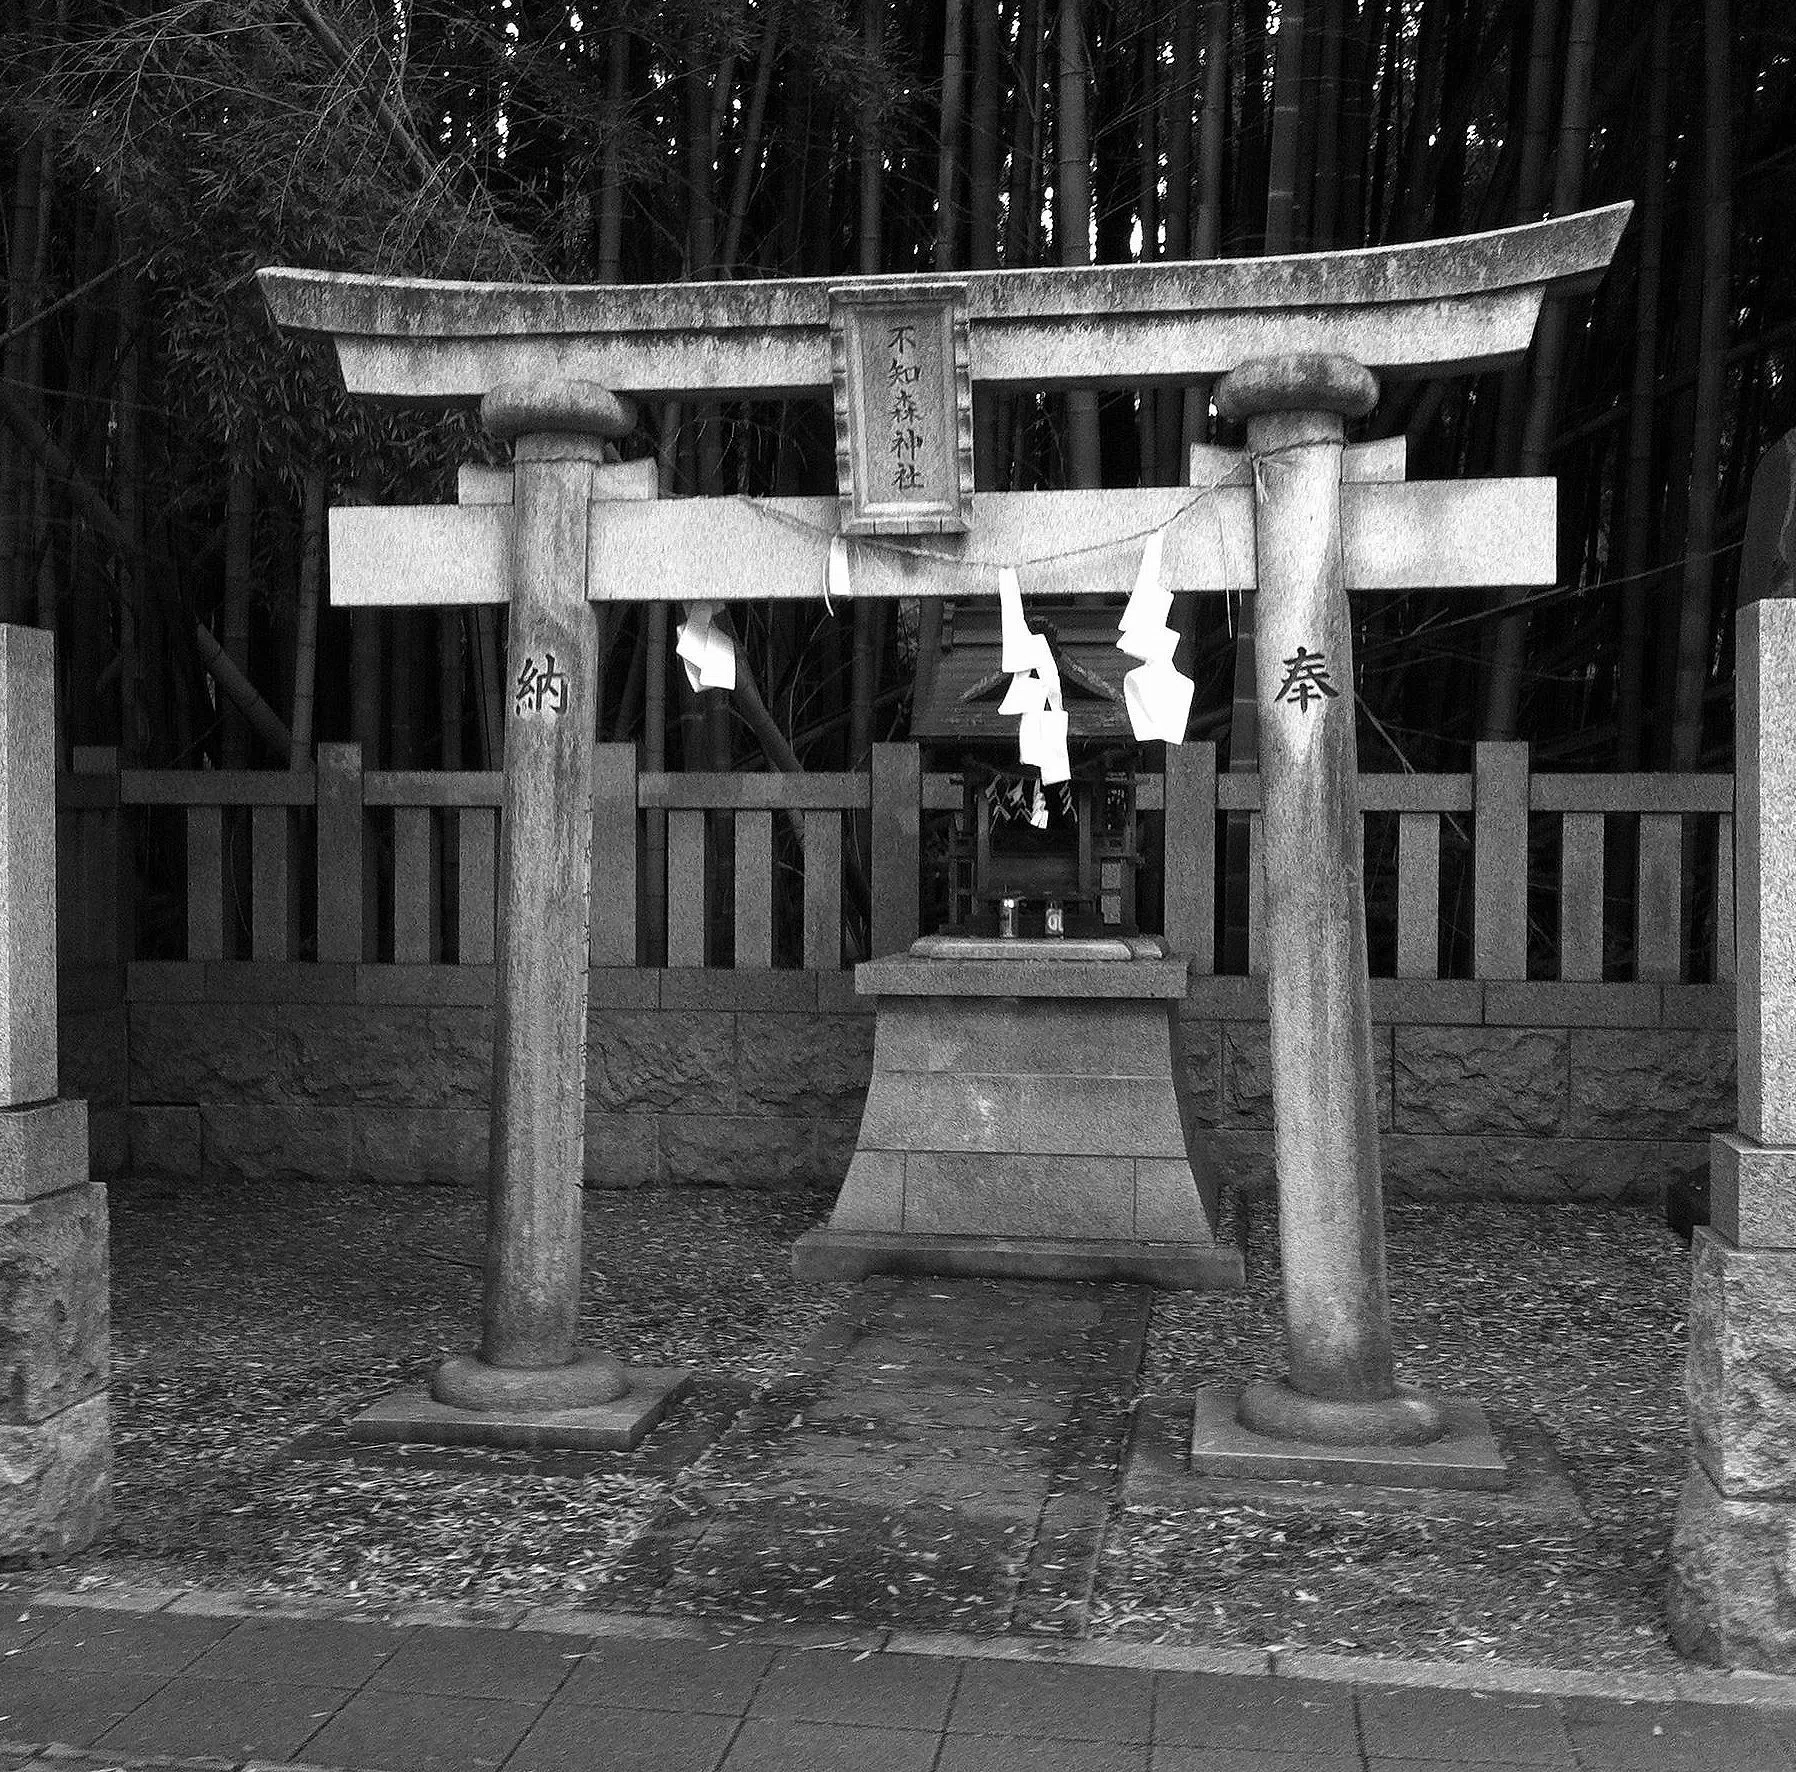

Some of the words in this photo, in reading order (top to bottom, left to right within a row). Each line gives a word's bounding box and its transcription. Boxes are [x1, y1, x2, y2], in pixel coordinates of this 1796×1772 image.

[887, 325, 925, 490] 不知森神社
[515, 653, 569, 717] 納
[1273, 646, 1340, 714] 奉
